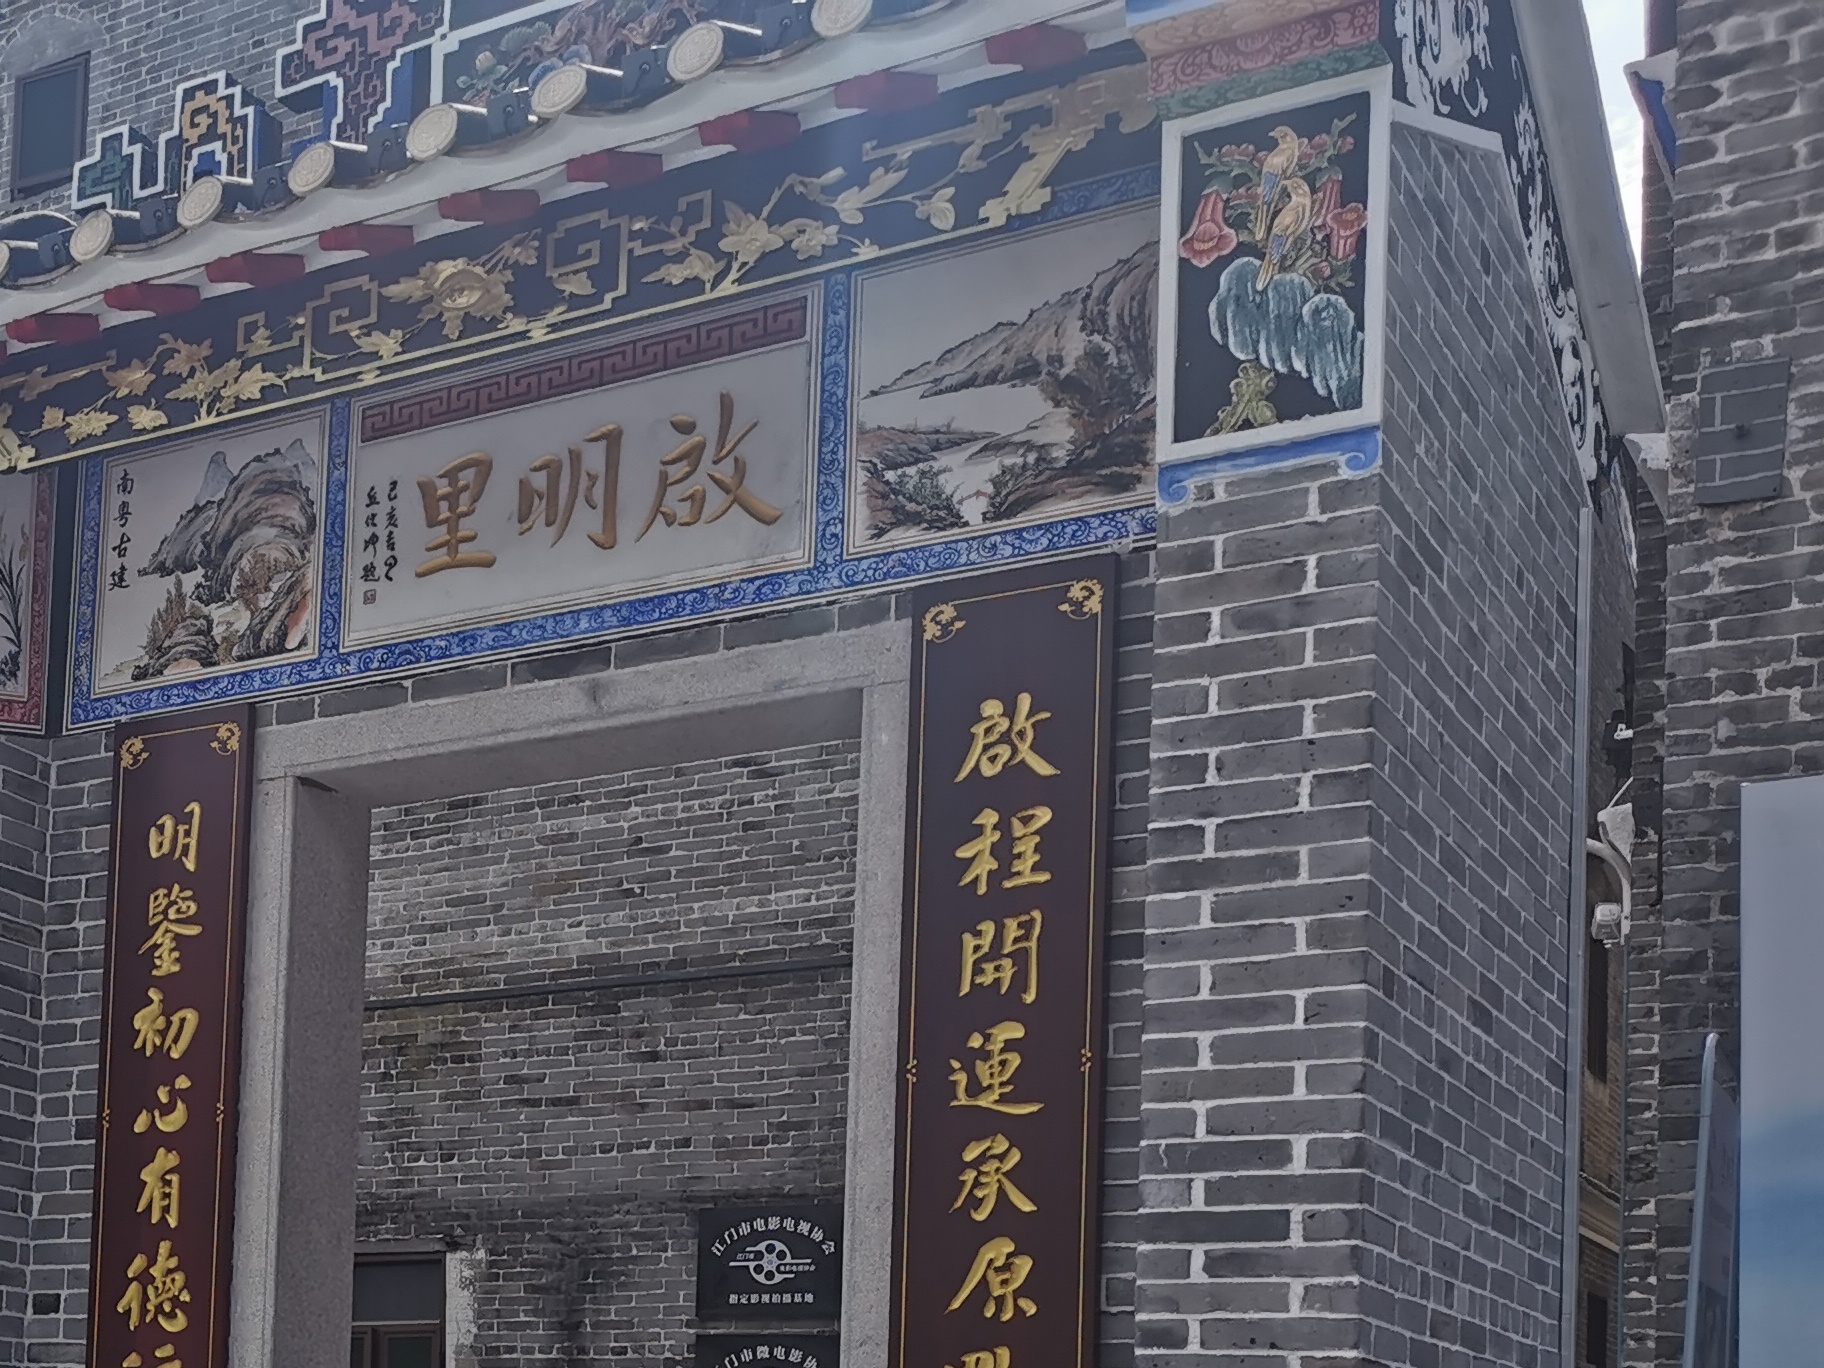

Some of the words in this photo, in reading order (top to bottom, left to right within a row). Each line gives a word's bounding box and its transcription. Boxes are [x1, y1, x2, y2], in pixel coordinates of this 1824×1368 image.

[711, 1216, 836, 1257] 江门市电影电视协会
[729, 1293, 814, 1305] 指定影视拍摄基地
